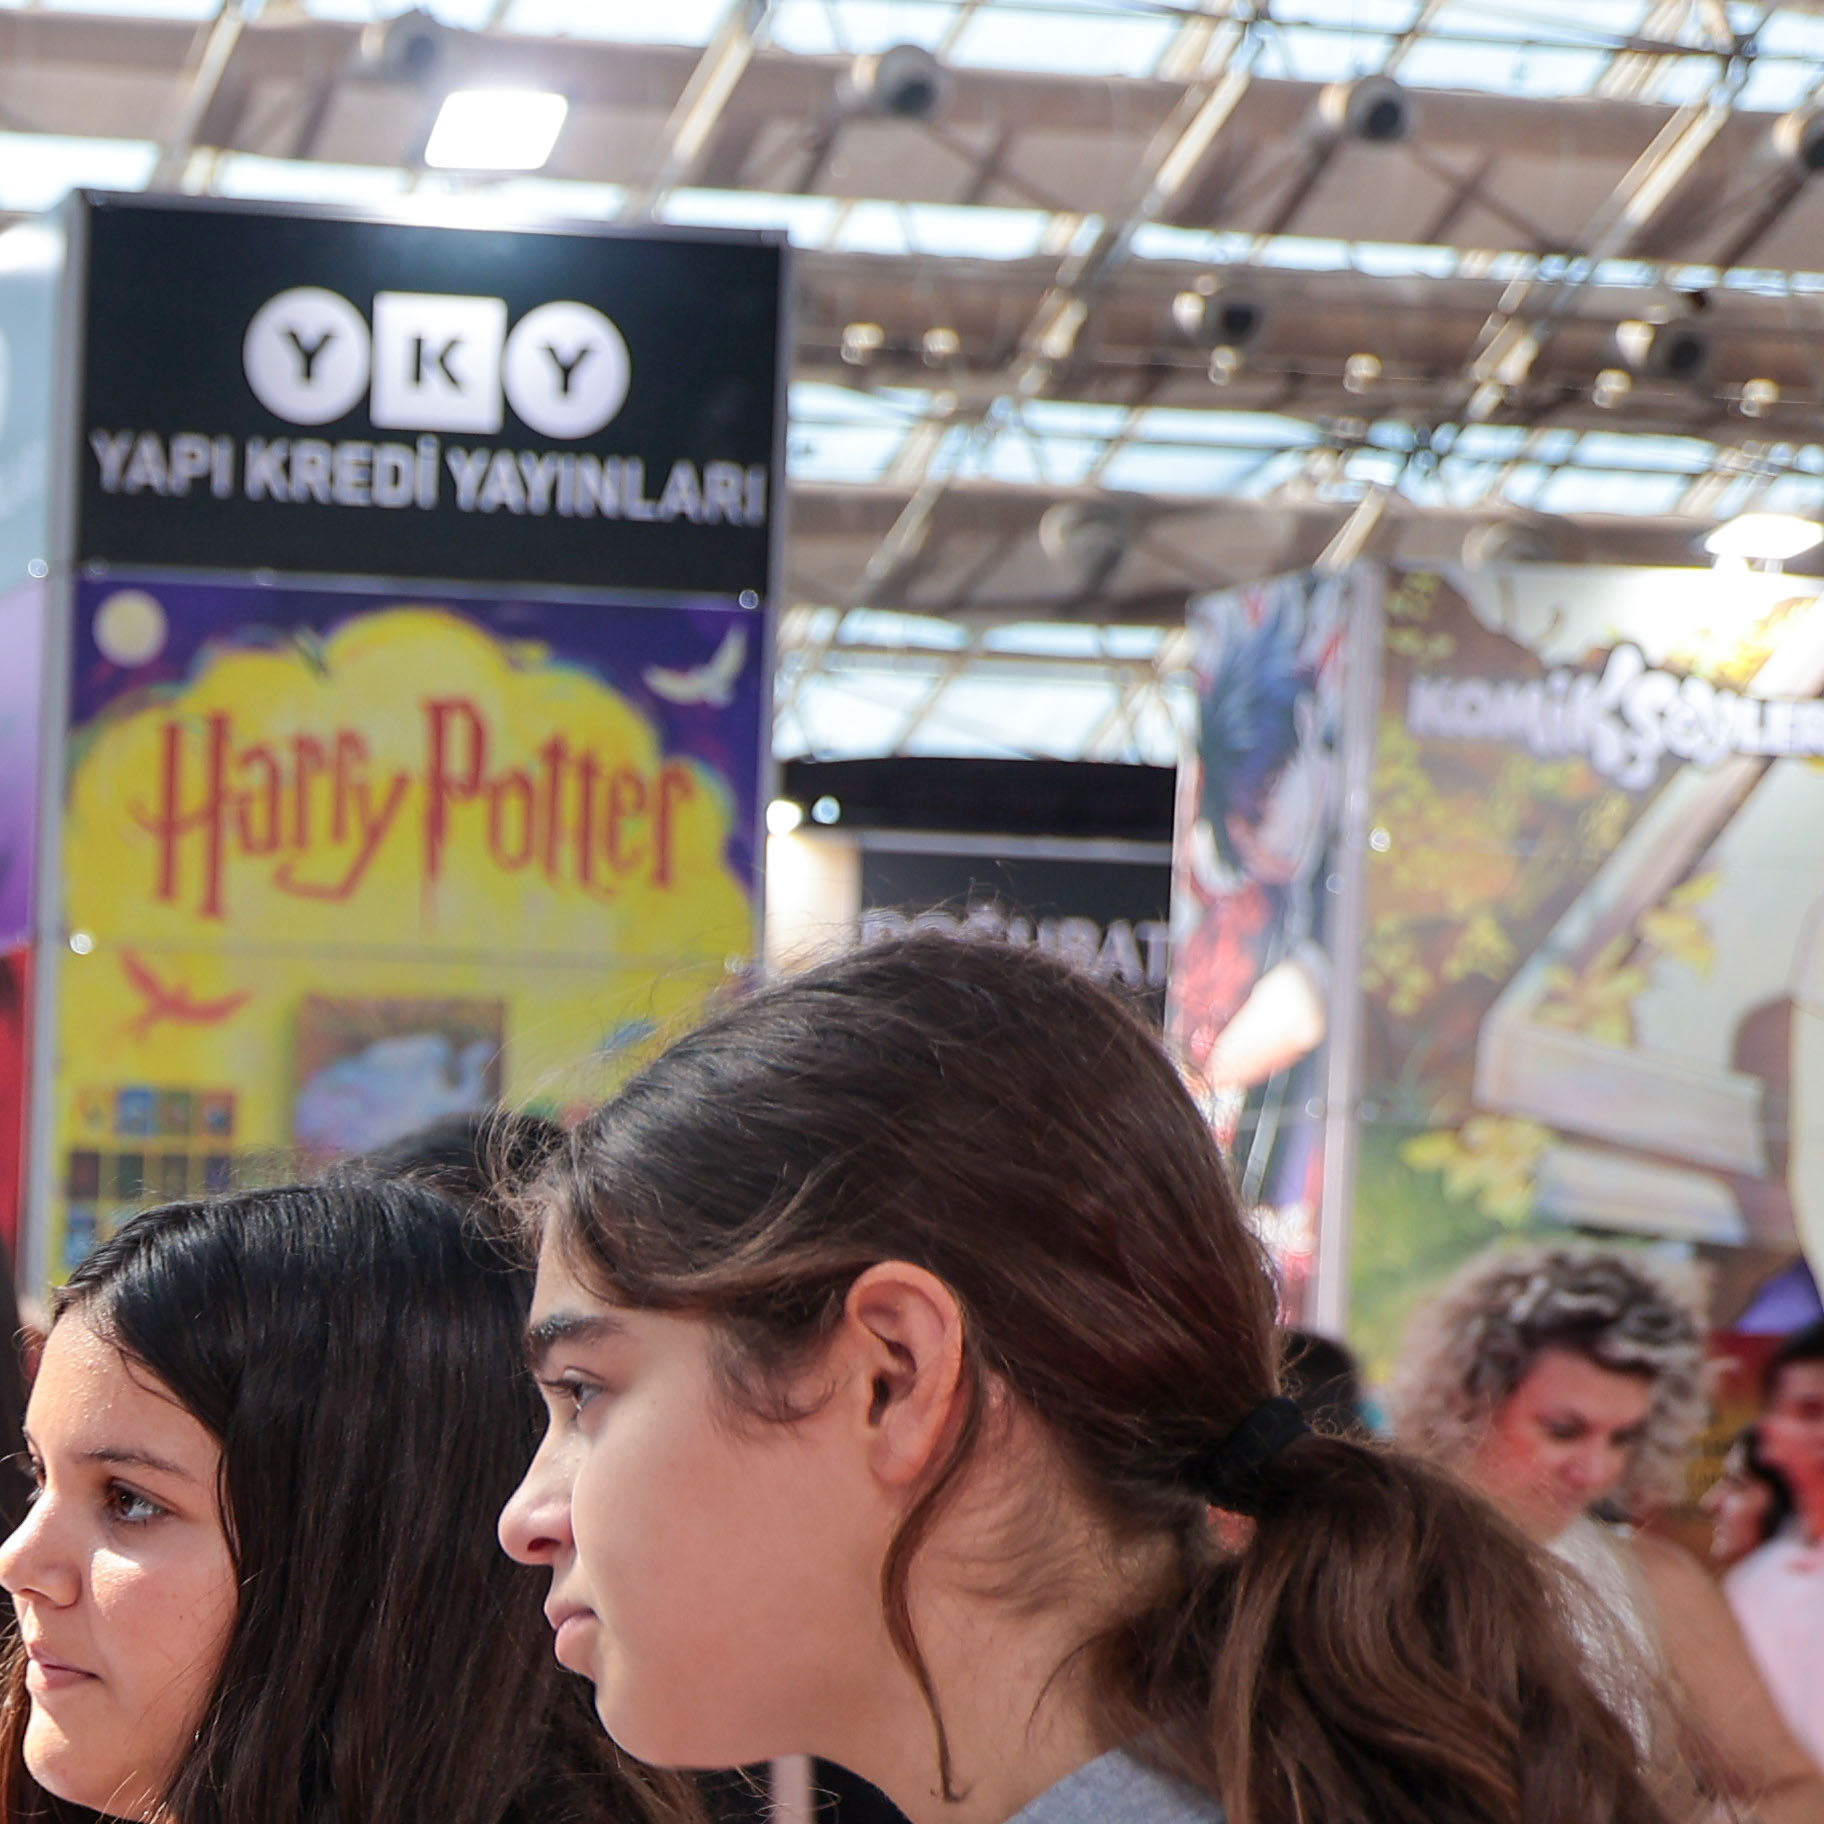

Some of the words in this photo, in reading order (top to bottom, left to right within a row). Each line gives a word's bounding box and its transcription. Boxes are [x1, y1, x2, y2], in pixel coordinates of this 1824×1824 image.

[89, 428, 232, 498] YAPI
[245, 433, 441, 511] KREDİ
[446, 446, 767, 527] YAYINLARI
[126, 710, 413, 920] Harry
[418, 694, 698, 930] Potter
